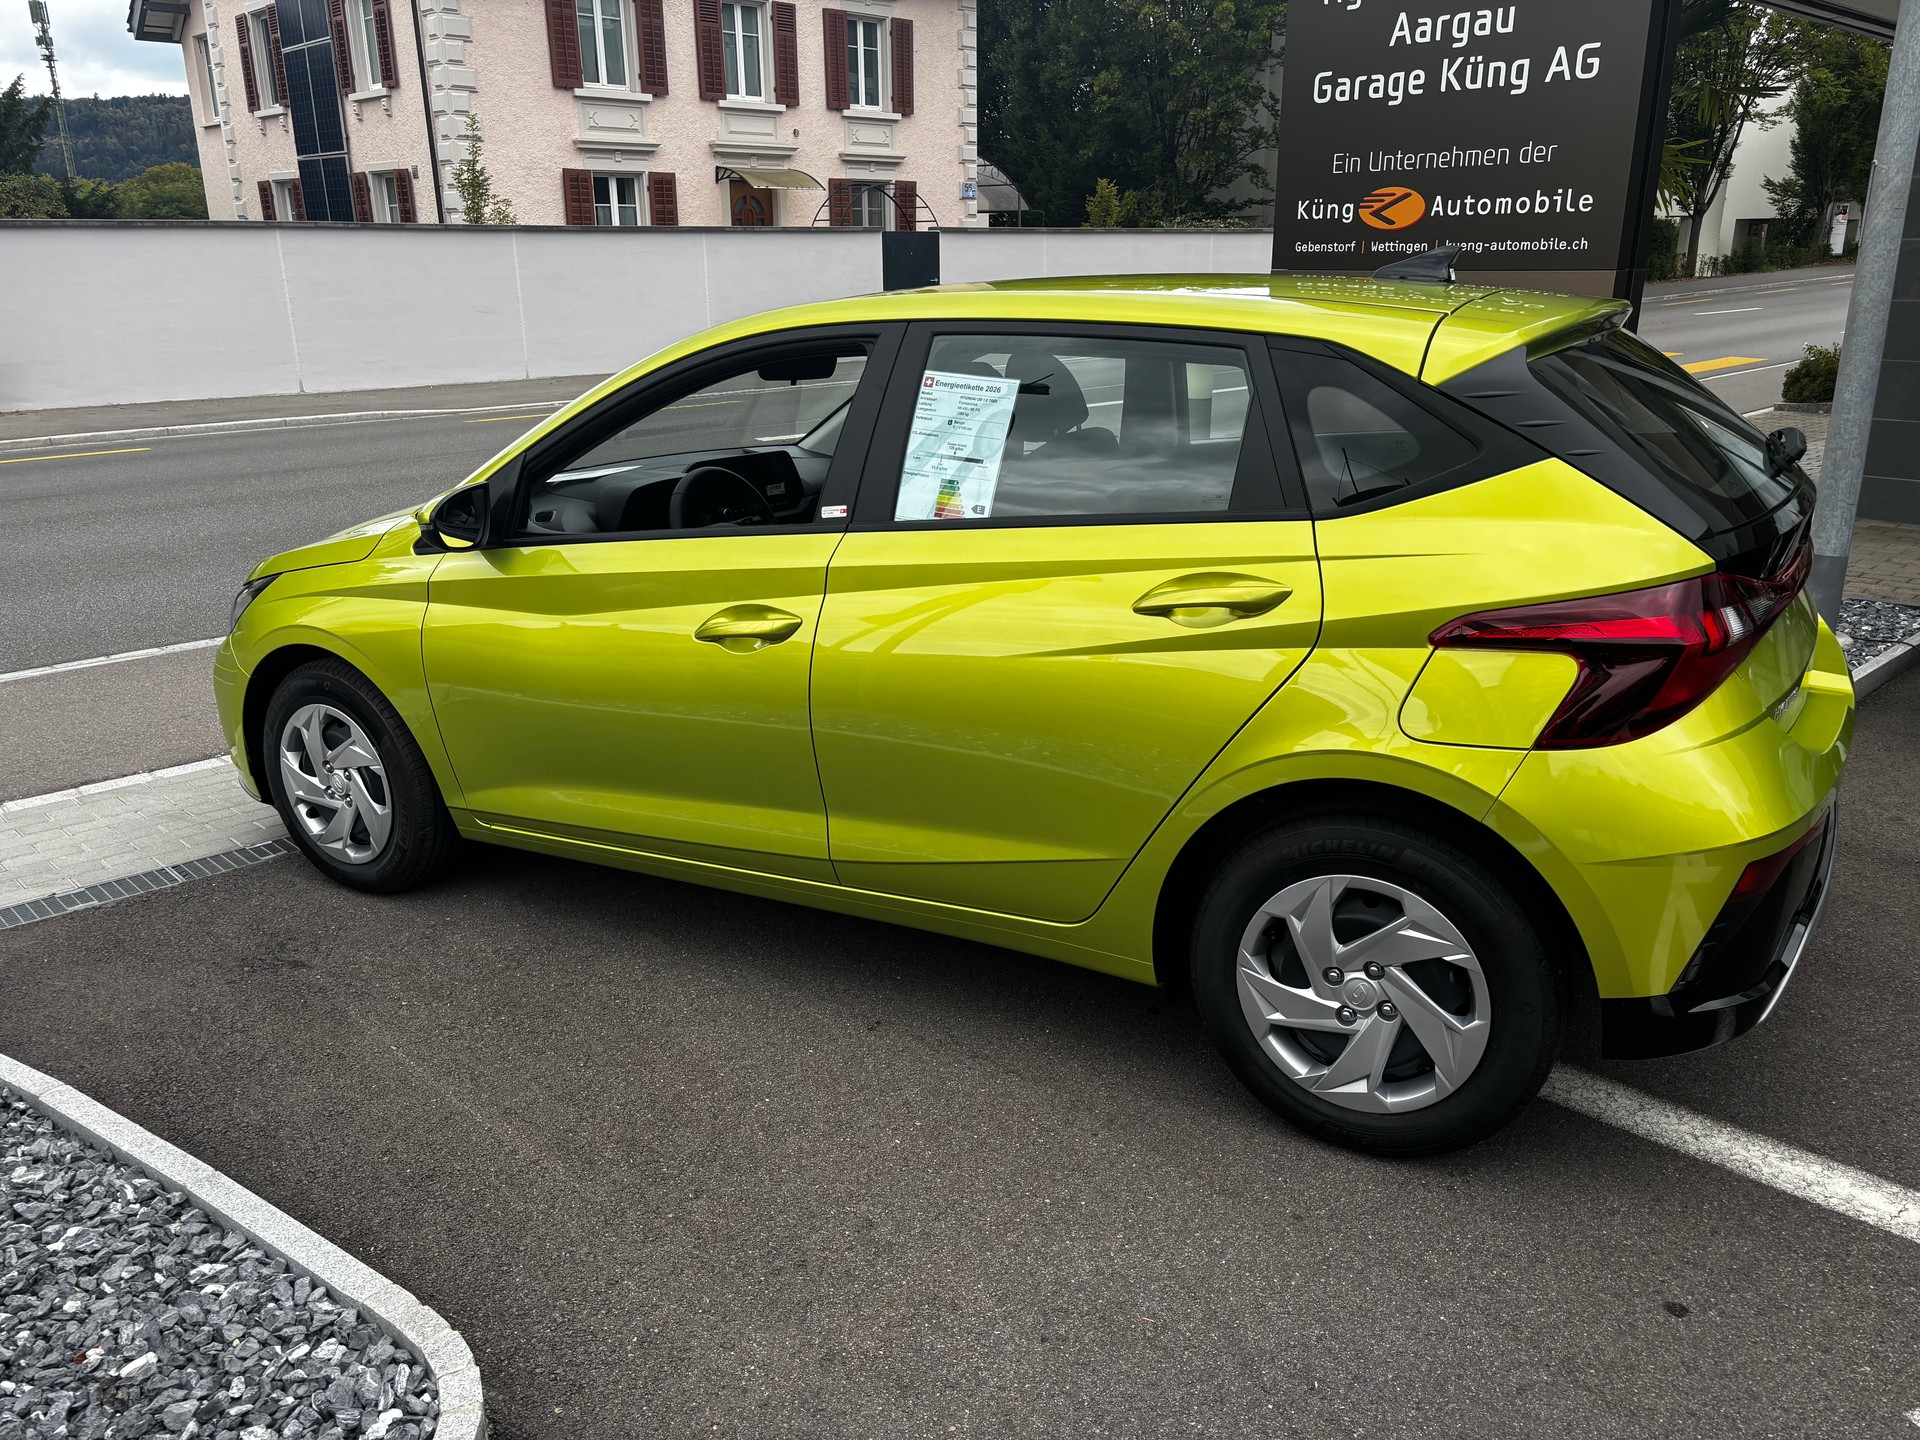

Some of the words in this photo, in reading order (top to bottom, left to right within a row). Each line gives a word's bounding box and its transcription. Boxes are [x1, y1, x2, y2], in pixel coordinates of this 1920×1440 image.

[1388, 6, 1515, 48] Aargau
[1313, 68, 1426, 106] Garage
[1439, 55, 1531, 95] Küng
[1544, 42, 1602, 83] AG
[1332, 153, 1361, 174] Ein
[1368, 145, 1510, 172] Unternehmen
[1519, 141, 1558, 164] der
[1296, 198, 1355, 224] Küng
[1430, 188, 1594, 217] Automobile
[1294, 241, 1356, 254] Gebenstorf
[1370, 240, 1428, 255] Wettingen
[1445, 237, 1588, 254] keng-automobile.ch
[935, 379, 984, 392] Energieetikette
[985, 386, 1002, 394] 2026
